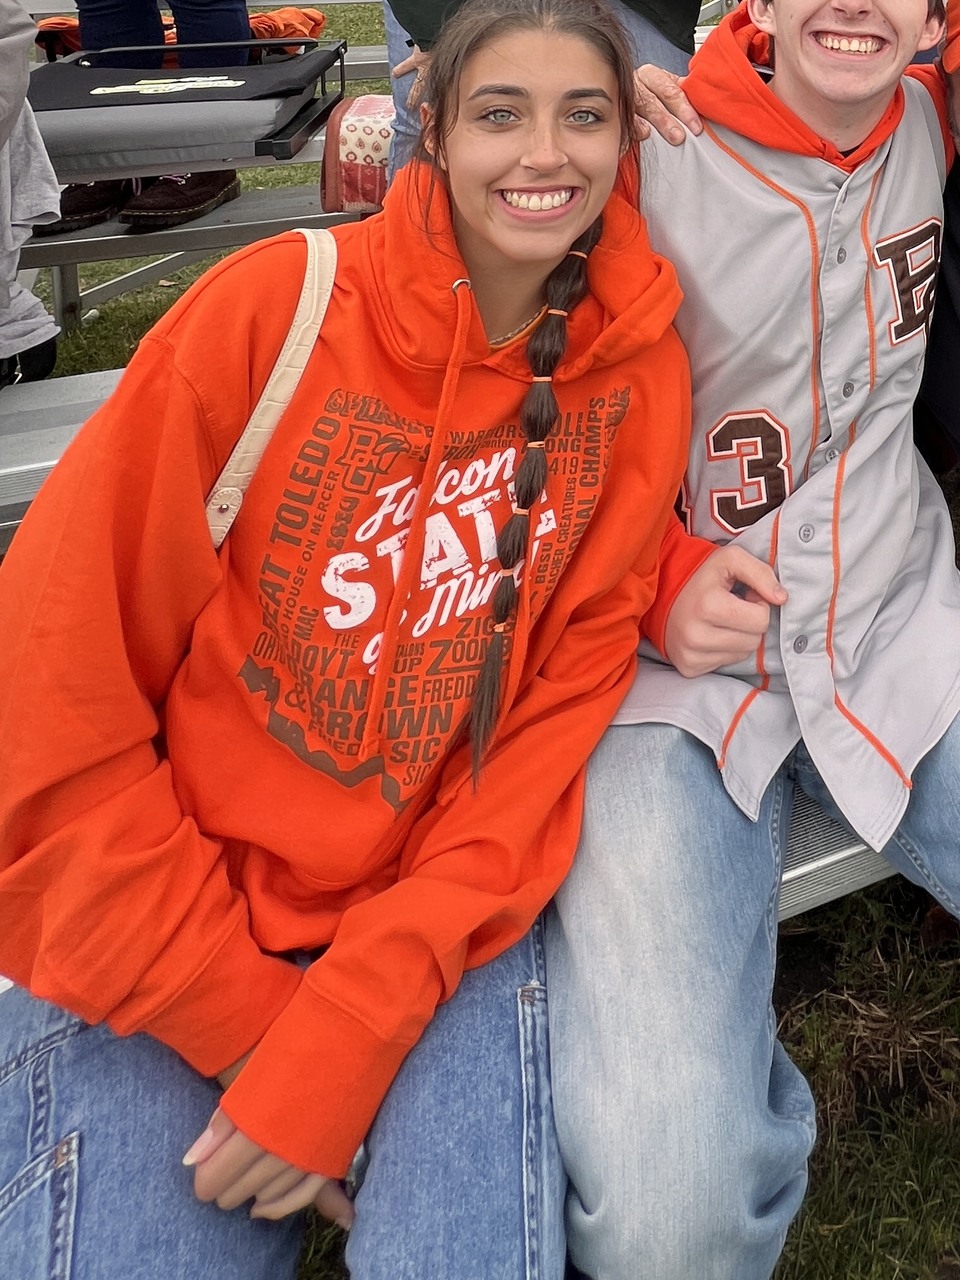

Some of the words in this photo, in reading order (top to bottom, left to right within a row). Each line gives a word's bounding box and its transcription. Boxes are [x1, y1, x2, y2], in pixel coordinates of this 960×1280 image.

[578, 396, 606, 488] CHAMPS
[270, 415, 341, 547] TOLEDO
[549, 457, 580, 476] 419
[557, 477, 578, 545] CREATURES
[283, 565, 307, 620] HOUSE
[302, 540, 317, 562] ON
[310, 470, 340, 536] MERCER
[321, 481, 557, 630] STAT
[535, 542, 554, 585] BGSU
[293, 606, 320, 641] MAC
[334, 633, 360, 649] THE
[392, 657, 422, 674] UP
[420, 673, 479, 704] FREDD
[389, 737, 441, 764] SIC
